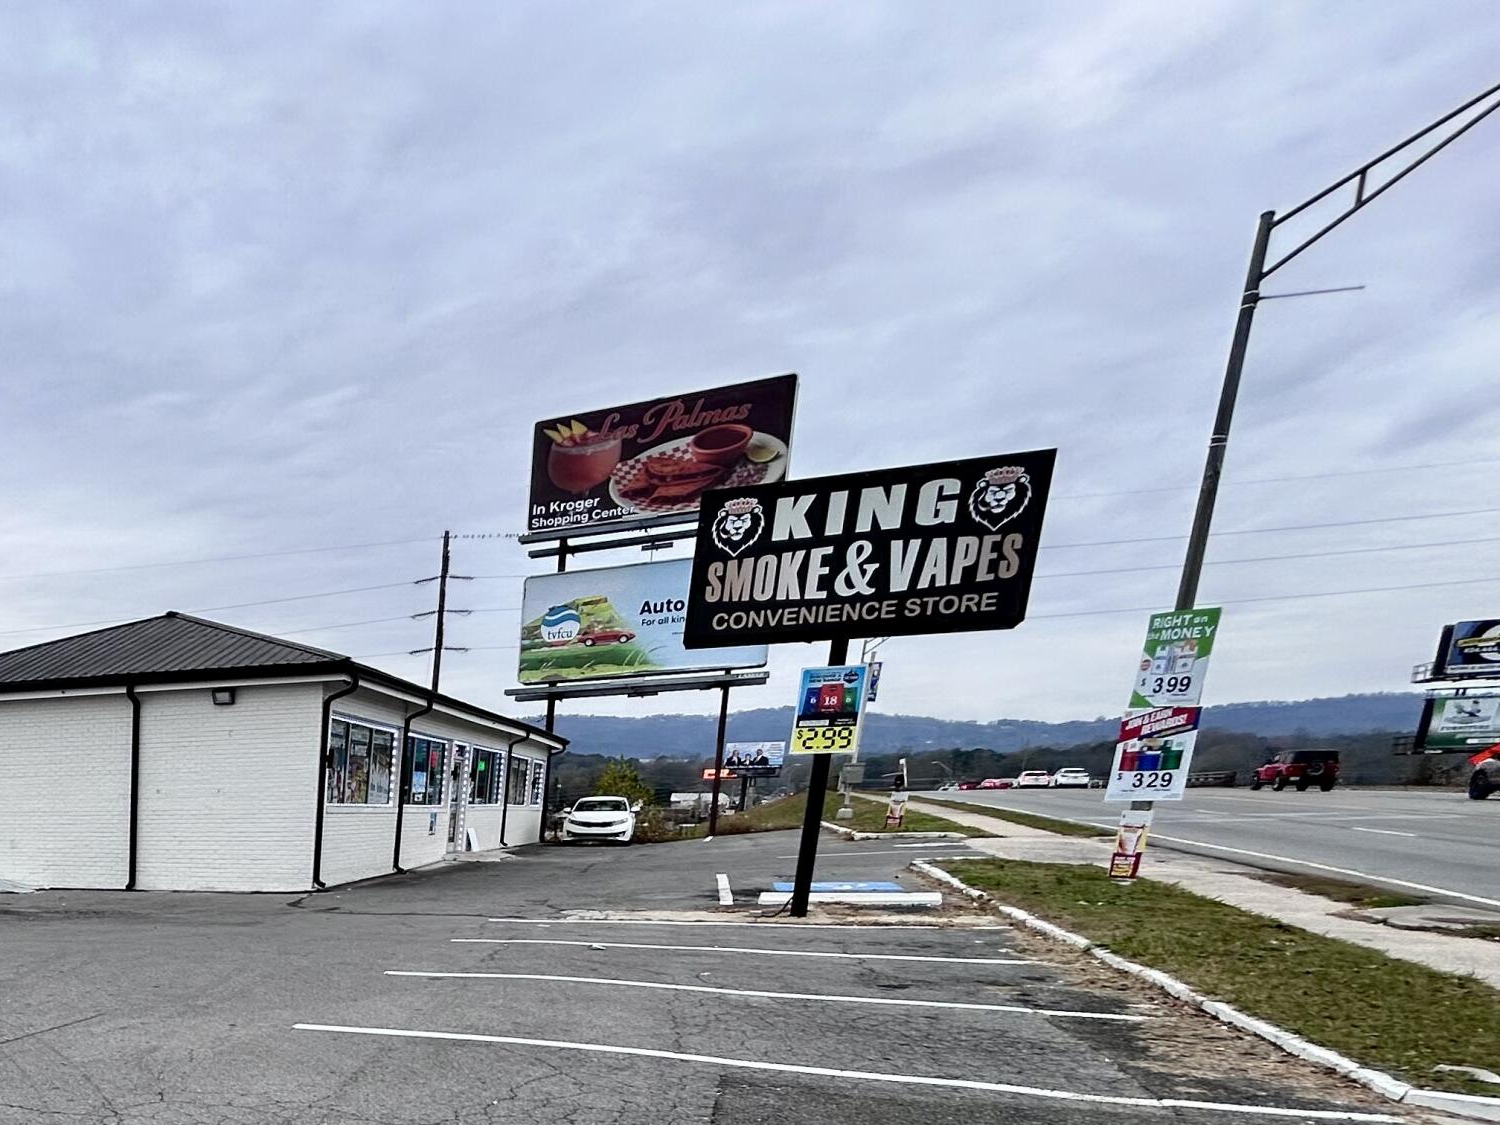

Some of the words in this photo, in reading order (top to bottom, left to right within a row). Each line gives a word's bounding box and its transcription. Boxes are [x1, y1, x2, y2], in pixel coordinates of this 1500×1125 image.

[599, 413, 639, 440] Las
[637, 399, 752, 443] Palmas
[532, 504, 546, 516] In
[550, 497, 600, 513] Kroger
[771, 478, 962, 541] KING
[531, 513, 589, 528] Shopping
[591, 507, 635, 519] Center
[704, 546, 834, 603] SMOKE
[834, 540, 880, 597] &
[889, 533, 1024, 592] VAPES
[639, 599, 686, 615] Auto
[712, 599, 898, 630] CONVENIENCE
[904, 592, 999, 616] STORE
[641, 618, 655, 626] For
[657, 616, 669, 625] all
[1152, 614, 1193, 629] RIGHT
[1193, 615, 1208, 624] on
[1160, 625, 1215, 640] MONEY
[824, 695, 838, 706] 18
